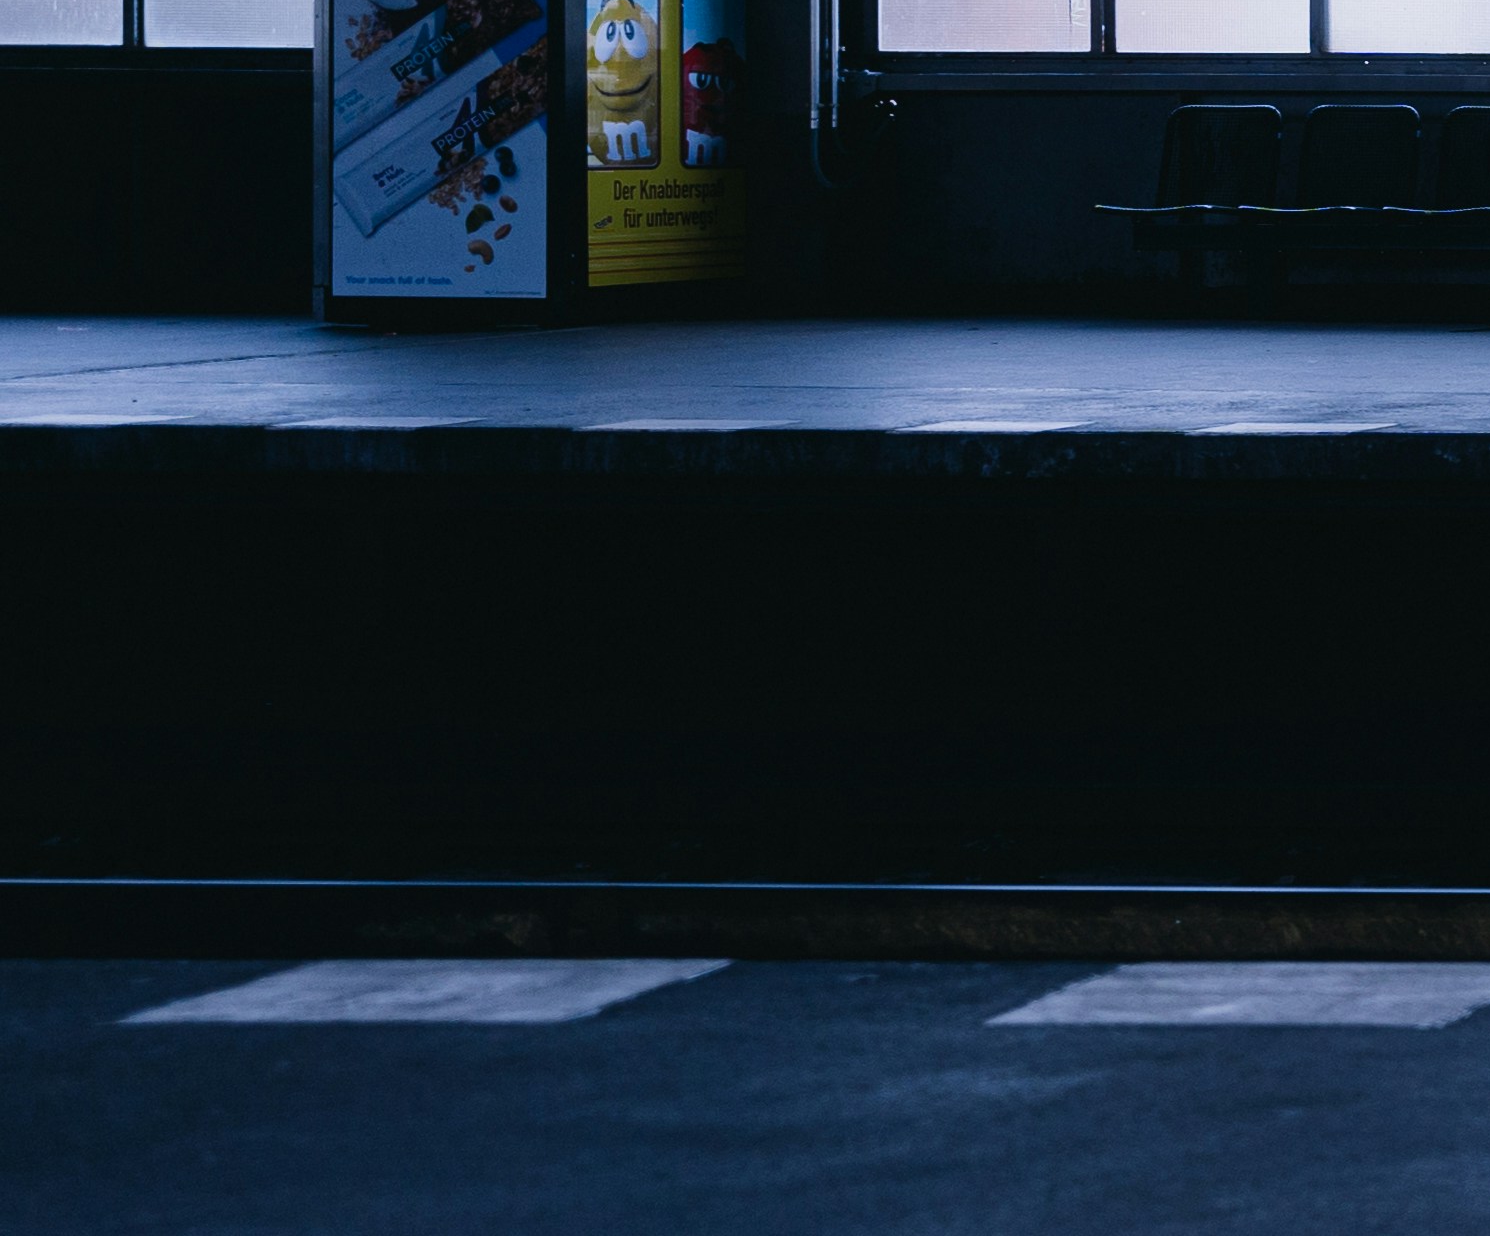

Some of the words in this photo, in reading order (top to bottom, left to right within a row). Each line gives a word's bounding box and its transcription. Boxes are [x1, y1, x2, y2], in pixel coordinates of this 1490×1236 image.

[394, 31, 456, 79] PROTEIN
[435, 105, 497, 152] PROTEIN
[613, 180, 637, 201] Der
[623, 209, 642, 228] für
